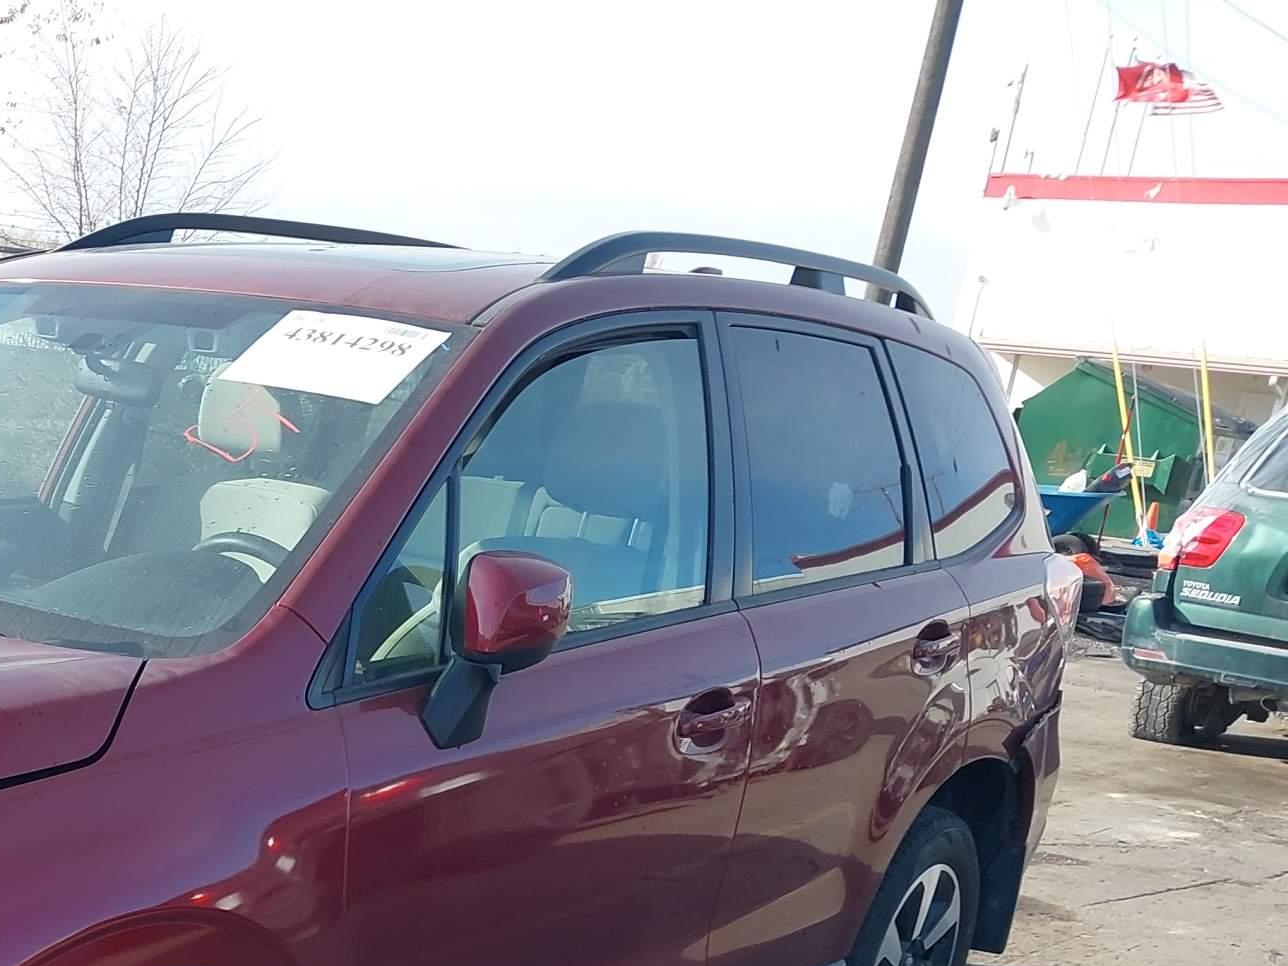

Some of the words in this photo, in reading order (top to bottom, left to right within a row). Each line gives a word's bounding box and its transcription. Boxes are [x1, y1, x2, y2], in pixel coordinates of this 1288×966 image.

[284, 327, 413, 356] 43814298
[1183, 580, 1210, 590] TOYOTA
[1179, 587, 1241, 605] SEQUOIA
